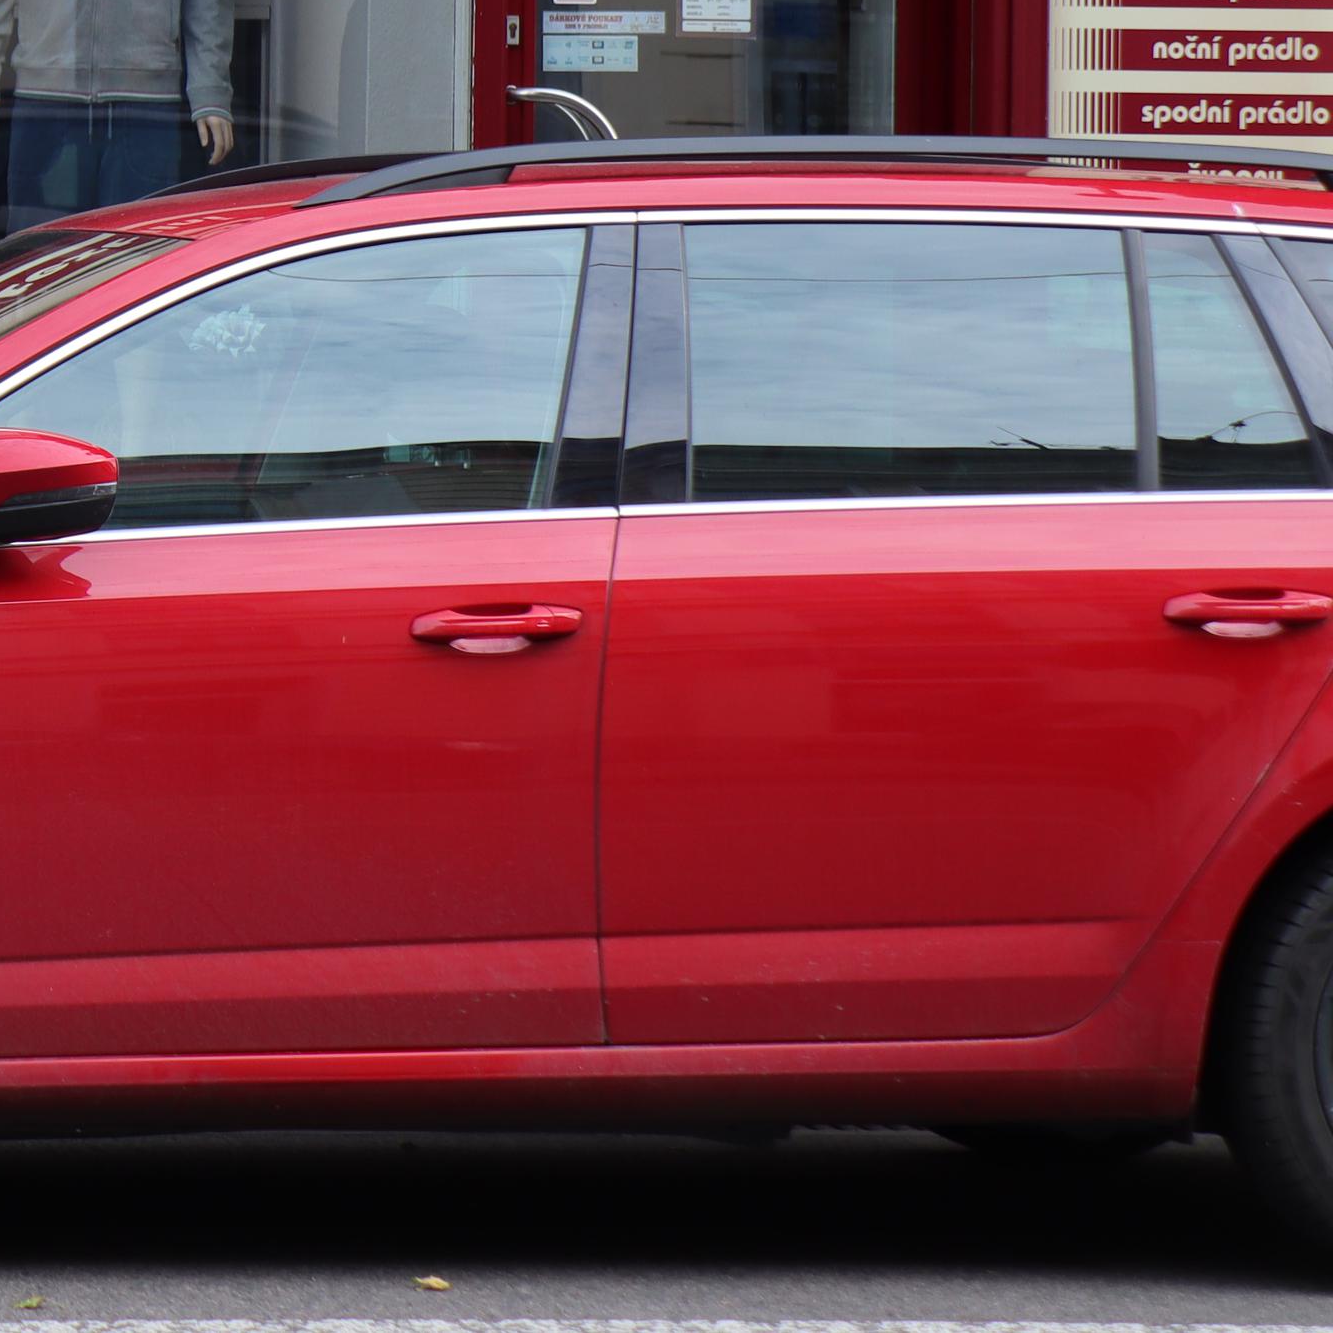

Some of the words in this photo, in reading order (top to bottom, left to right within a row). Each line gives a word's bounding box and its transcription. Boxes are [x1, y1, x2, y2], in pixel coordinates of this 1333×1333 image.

[1152, 35, 1223, 59] noční
[1228, 36, 1320, 66] prádlo
[1141, 99, 1233, 129] spodní
[1239, 100, 1331, 130] prádlo
